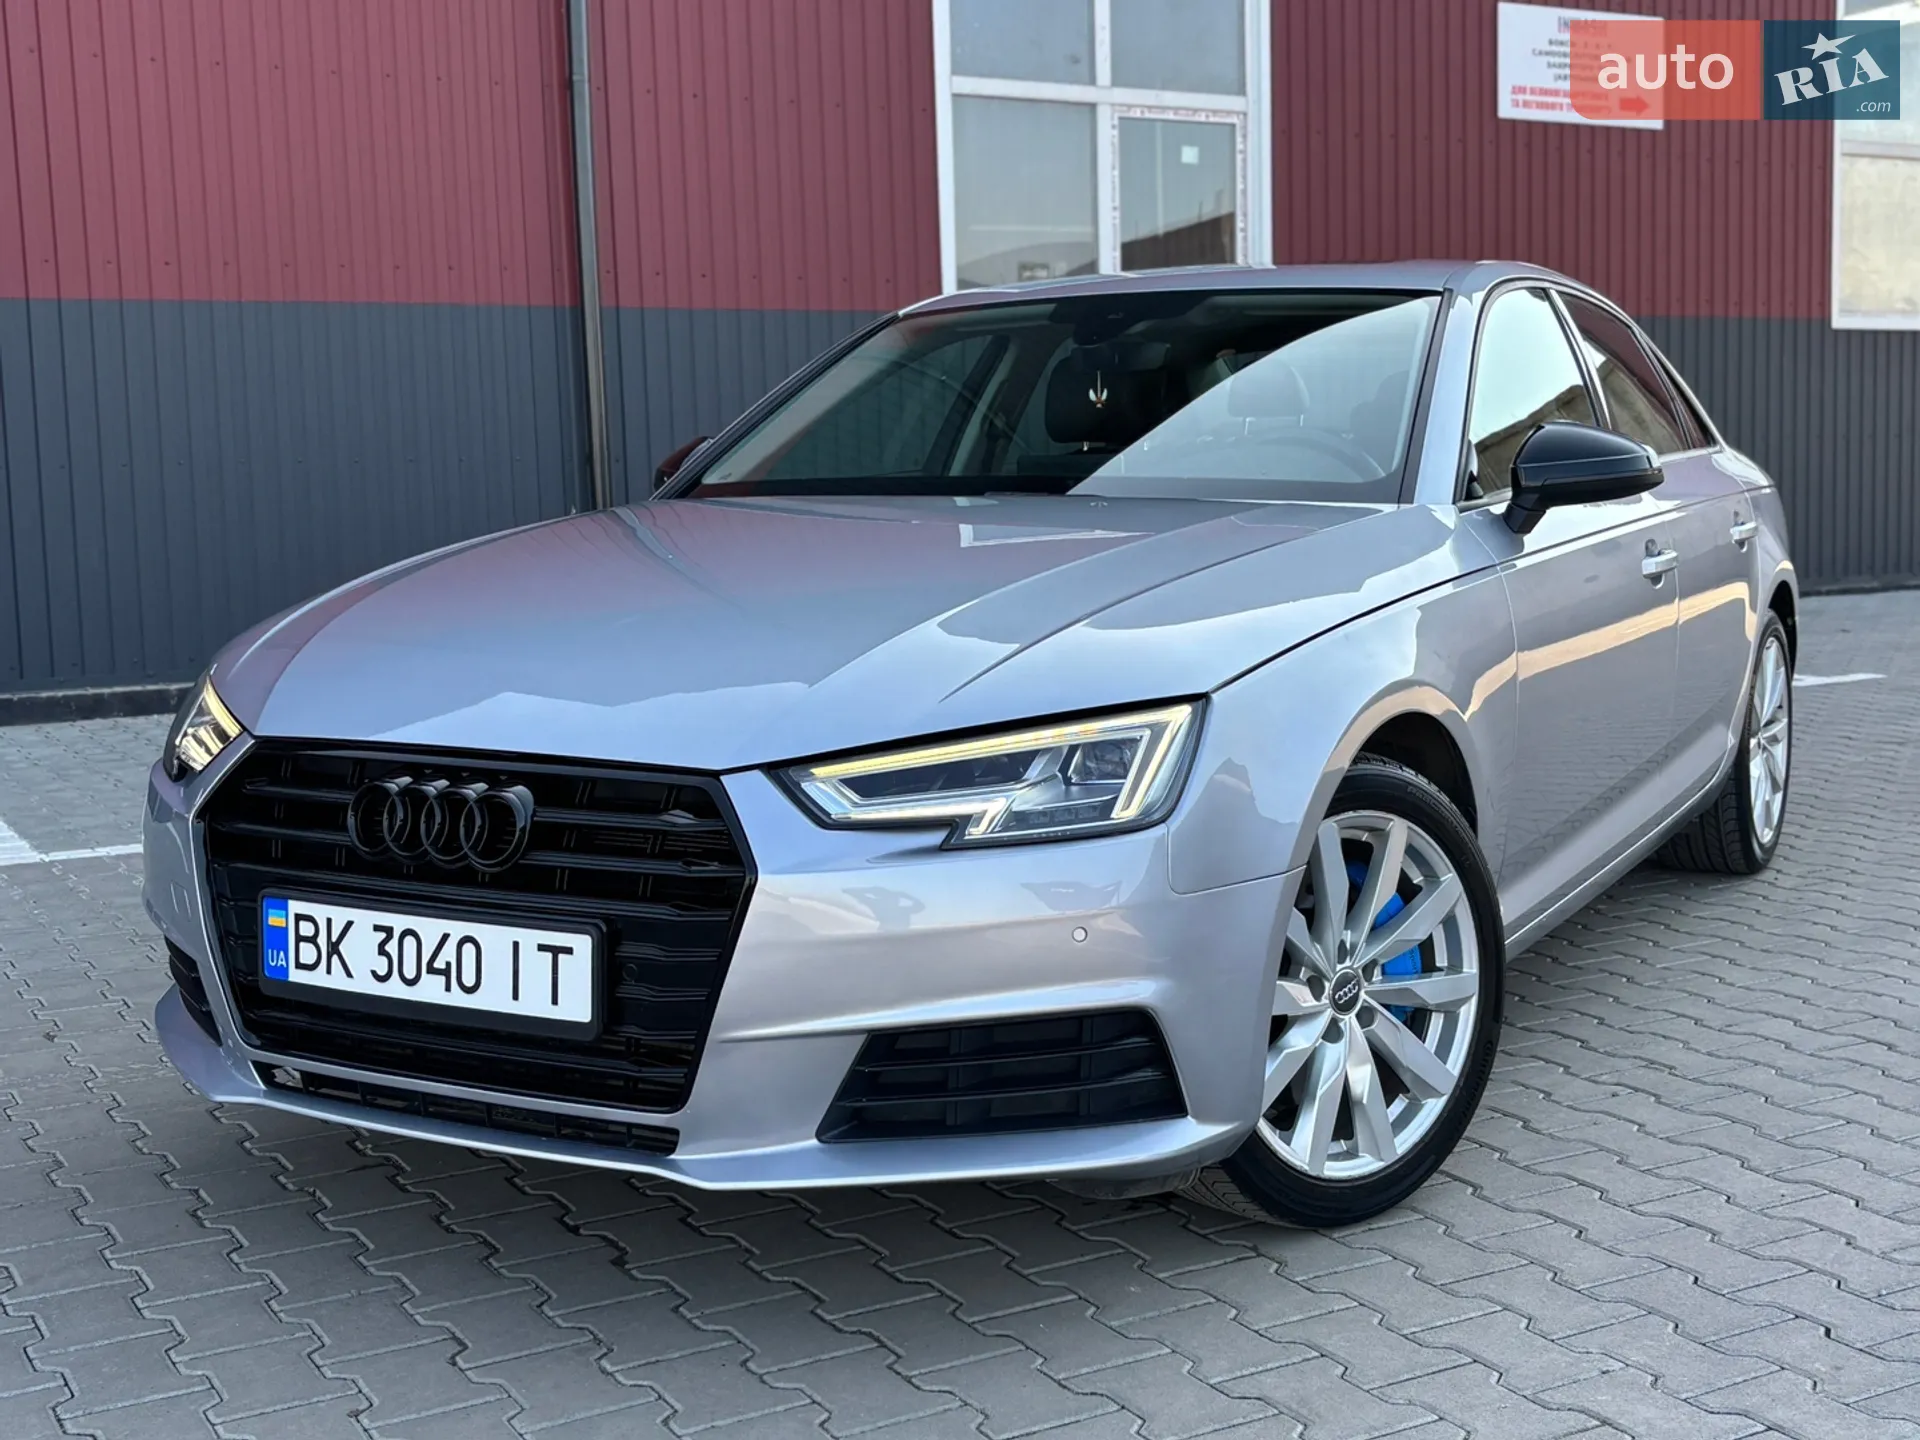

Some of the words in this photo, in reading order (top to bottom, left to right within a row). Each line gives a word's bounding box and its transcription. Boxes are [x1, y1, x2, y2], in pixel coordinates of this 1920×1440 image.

[268, 949, 287, 968] UA
[293, 912, 355, 979] BK
[370, 923, 483, 995] 3040
[511, 940, 575, 1006] IT
